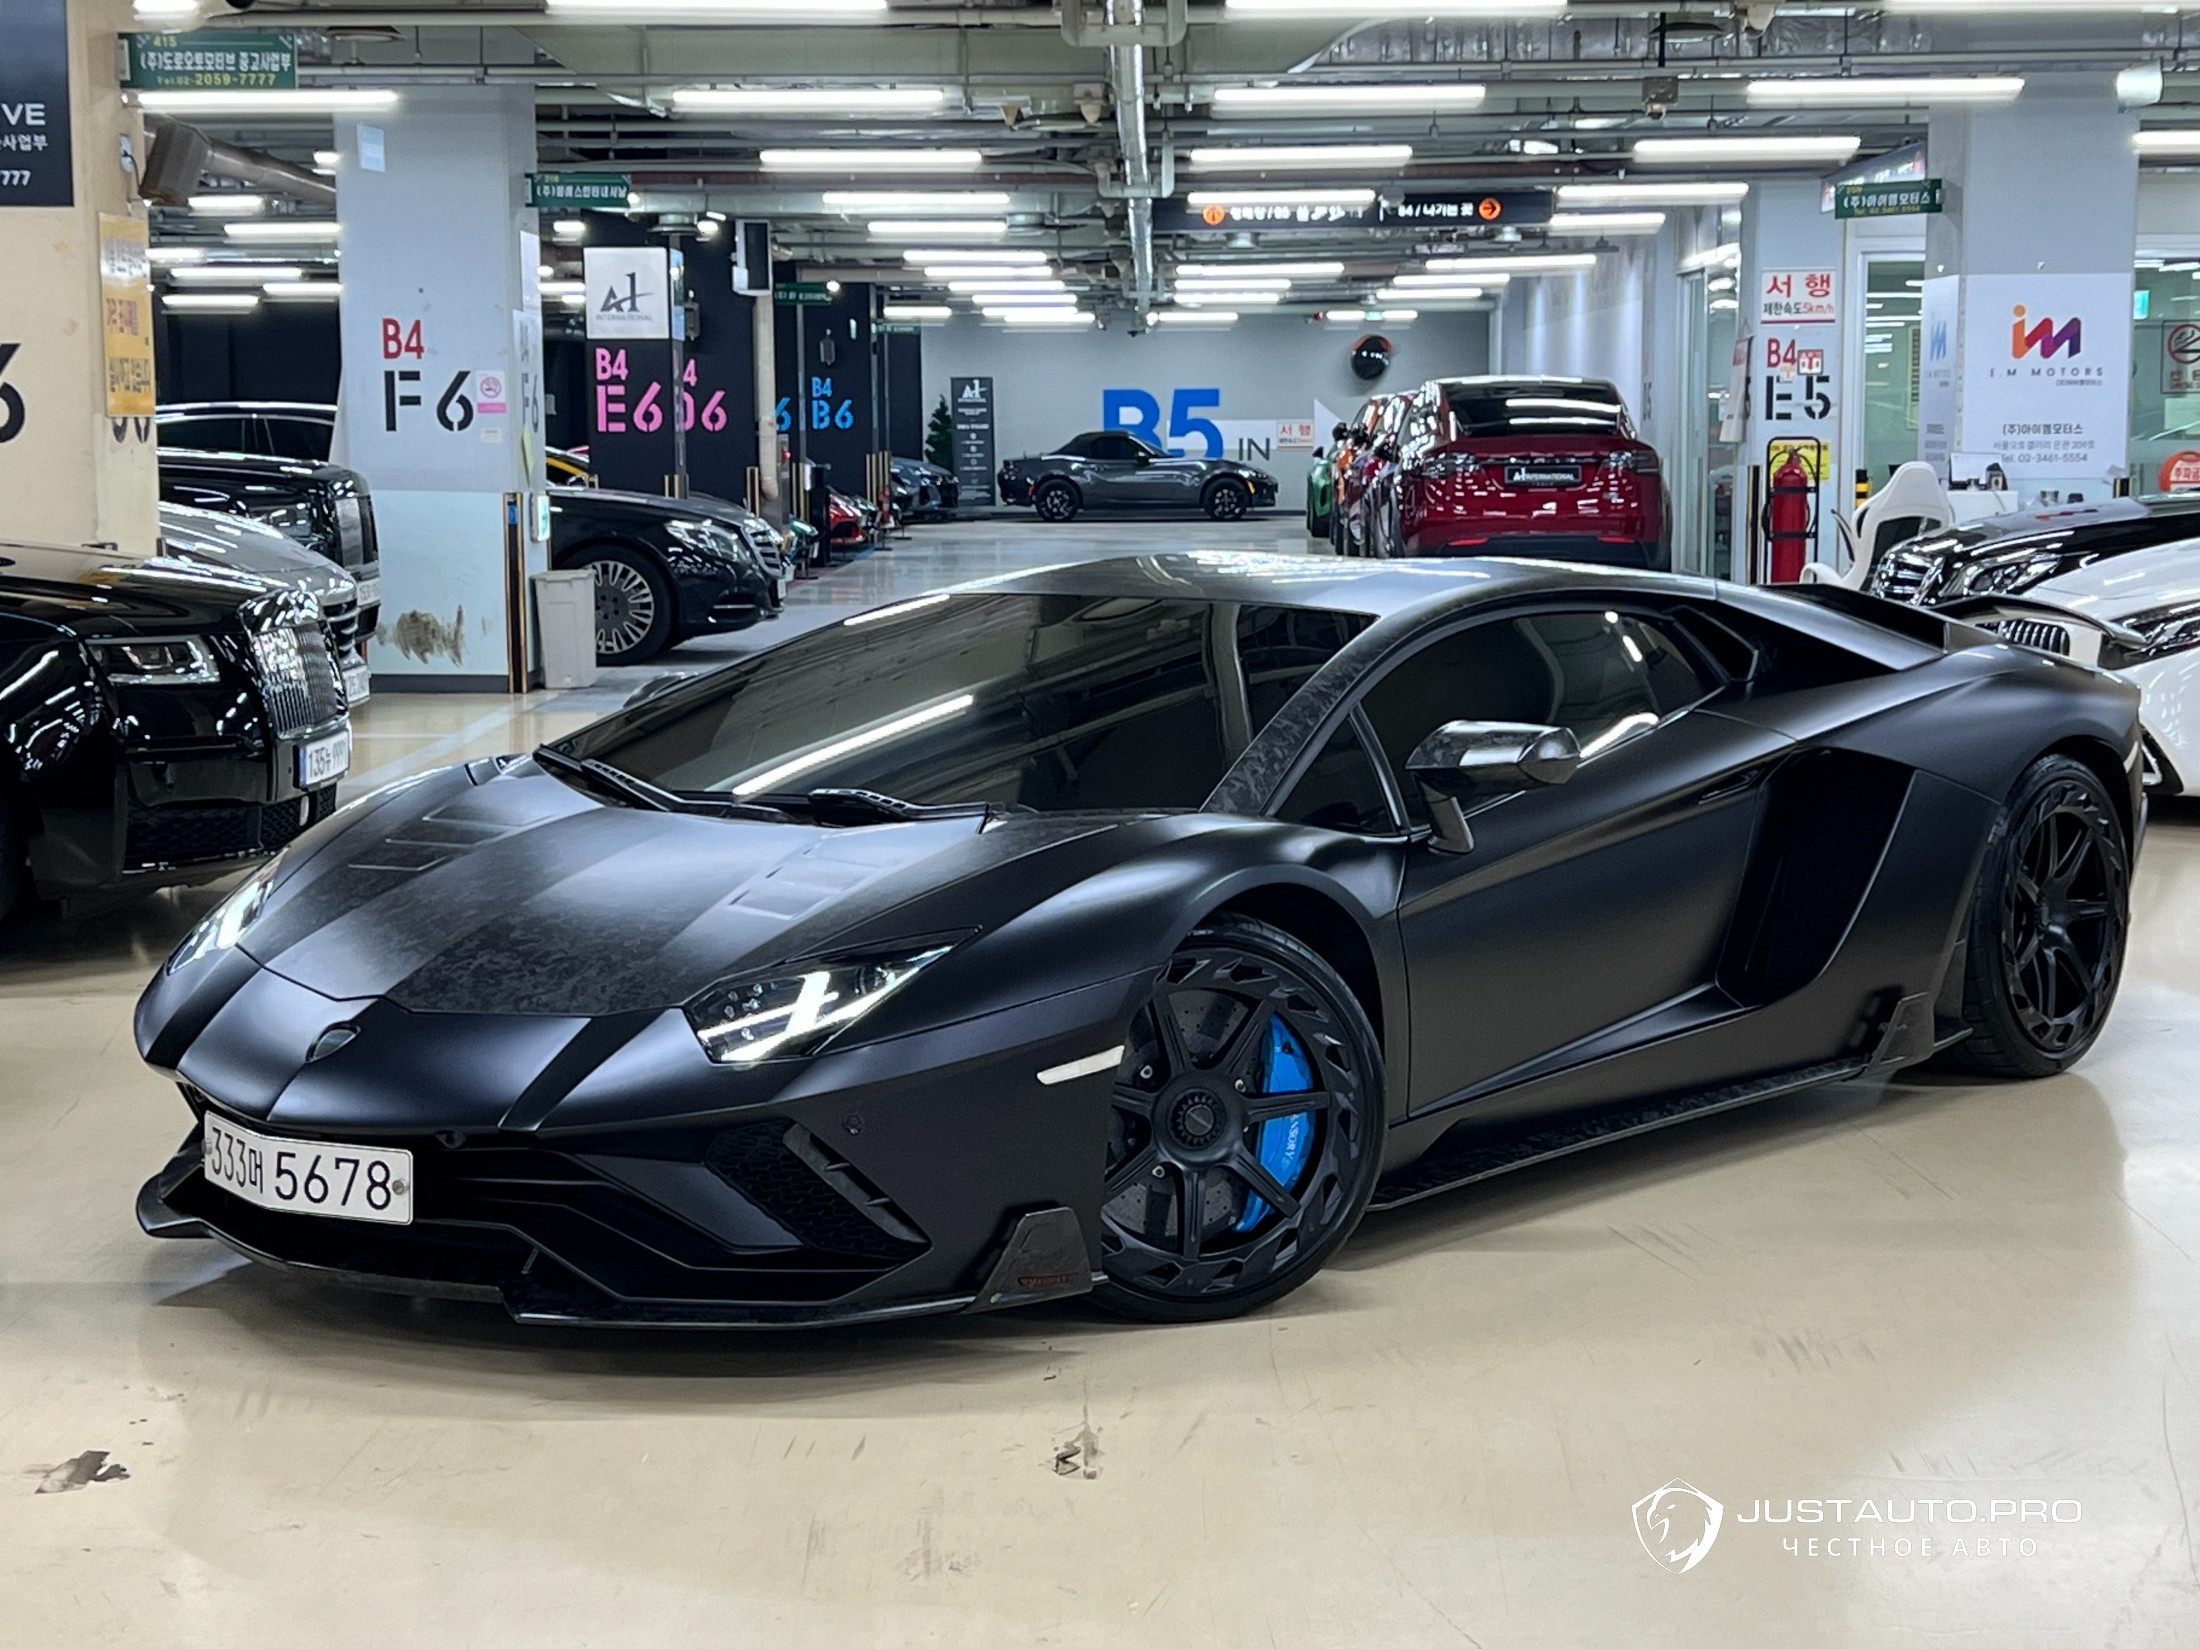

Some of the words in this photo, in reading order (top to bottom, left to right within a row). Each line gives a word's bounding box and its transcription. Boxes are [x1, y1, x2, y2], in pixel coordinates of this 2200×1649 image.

[383, 318, 425, 360] B4
[1767, 337, 1797, 368] B4
[595, 348, 628, 381] B4
[2030, 366, 2104, 378] MOTORS
[811, 377, 832, 398] B4
[812, 399, 854, 430] B6
[1102, 388, 1224, 461] B5
[1238, 438, 1271, 461] IN
[275, 1151, 392, 1210] 5678
